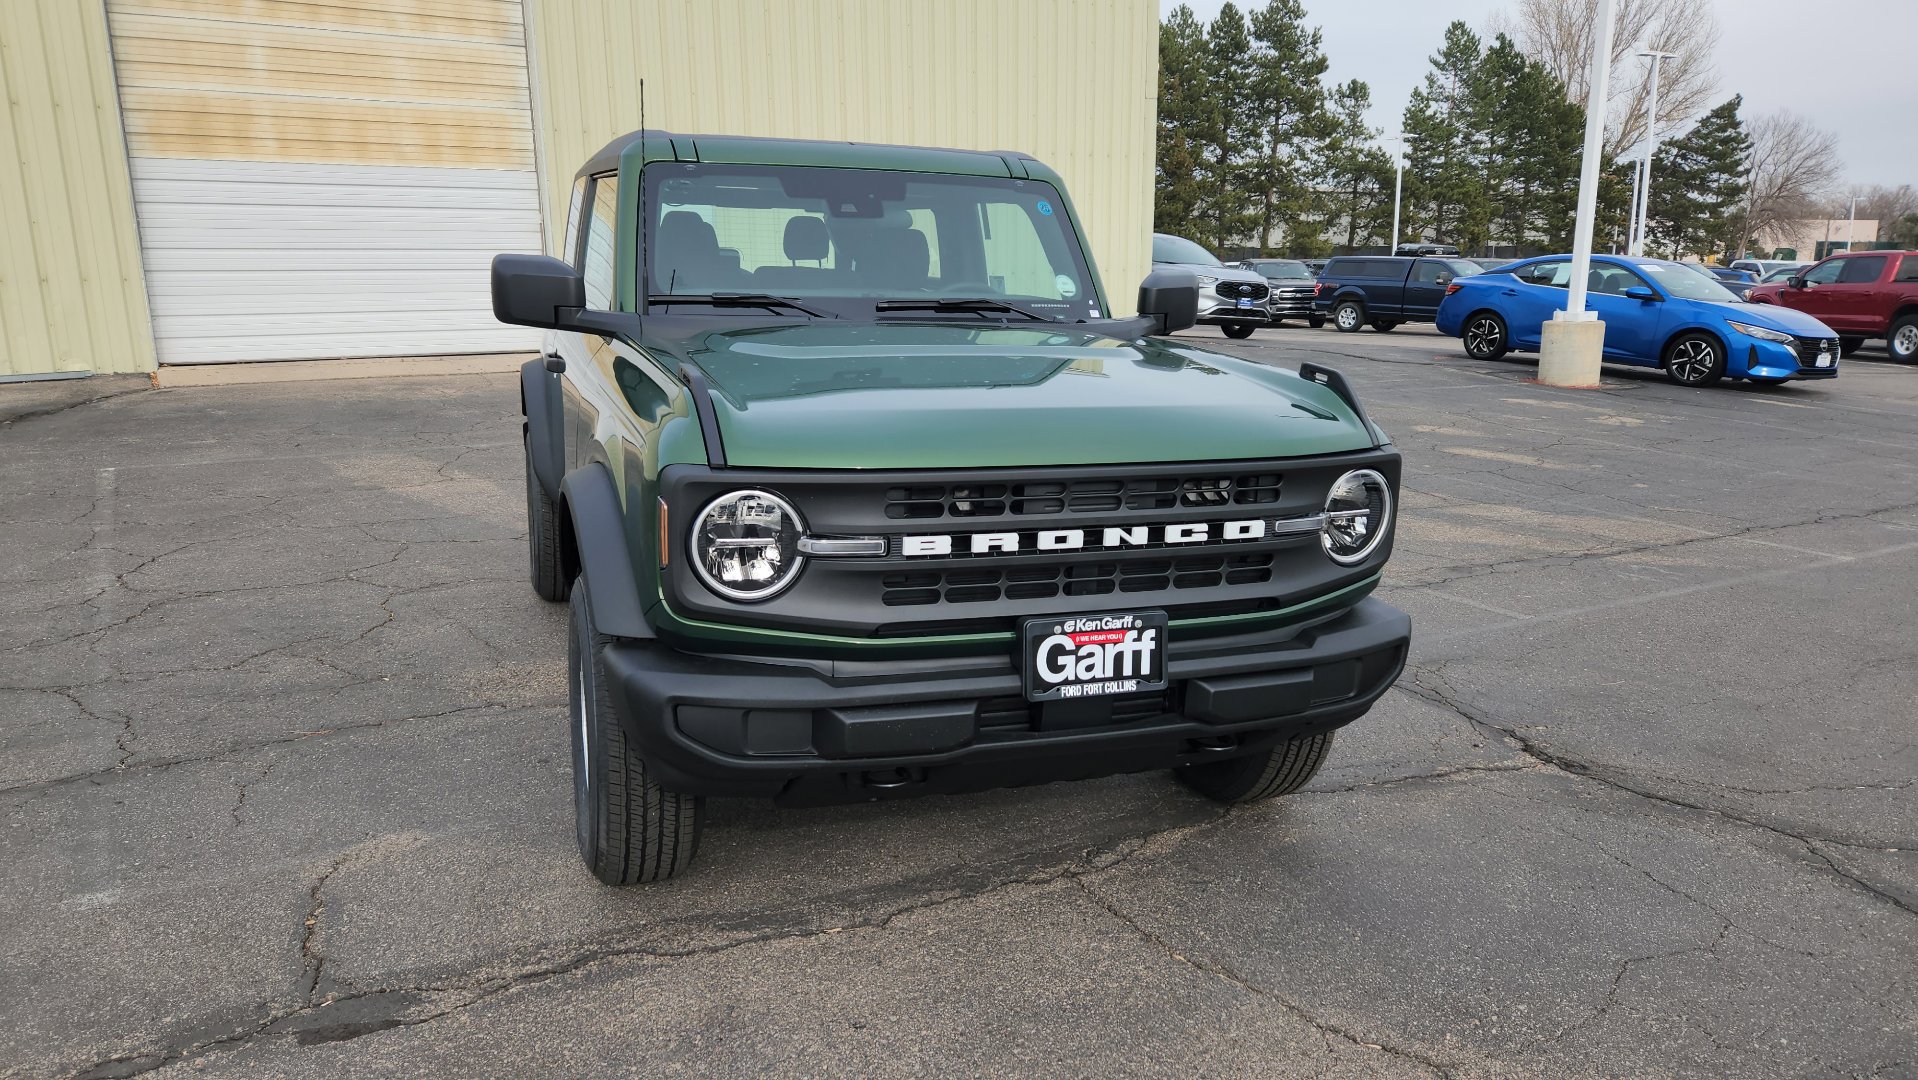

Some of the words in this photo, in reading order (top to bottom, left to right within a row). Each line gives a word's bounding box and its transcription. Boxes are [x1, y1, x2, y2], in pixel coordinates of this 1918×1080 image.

[902, 519, 1266, 556] BRONCO
[1075, 618, 1101, 632] Ken
[1101, 615, 1134, 630] Garff
[1090, 634, 1107, 642] HEAR
[1106, 633, 1119, 641] YOU
[1036, 628, 1156, 684] Garff
[1061, 685, 1082, 698] FORD
[1083, 683, 1103, 696] FORT
[1104, 680, 1137, 694] COLLINS
